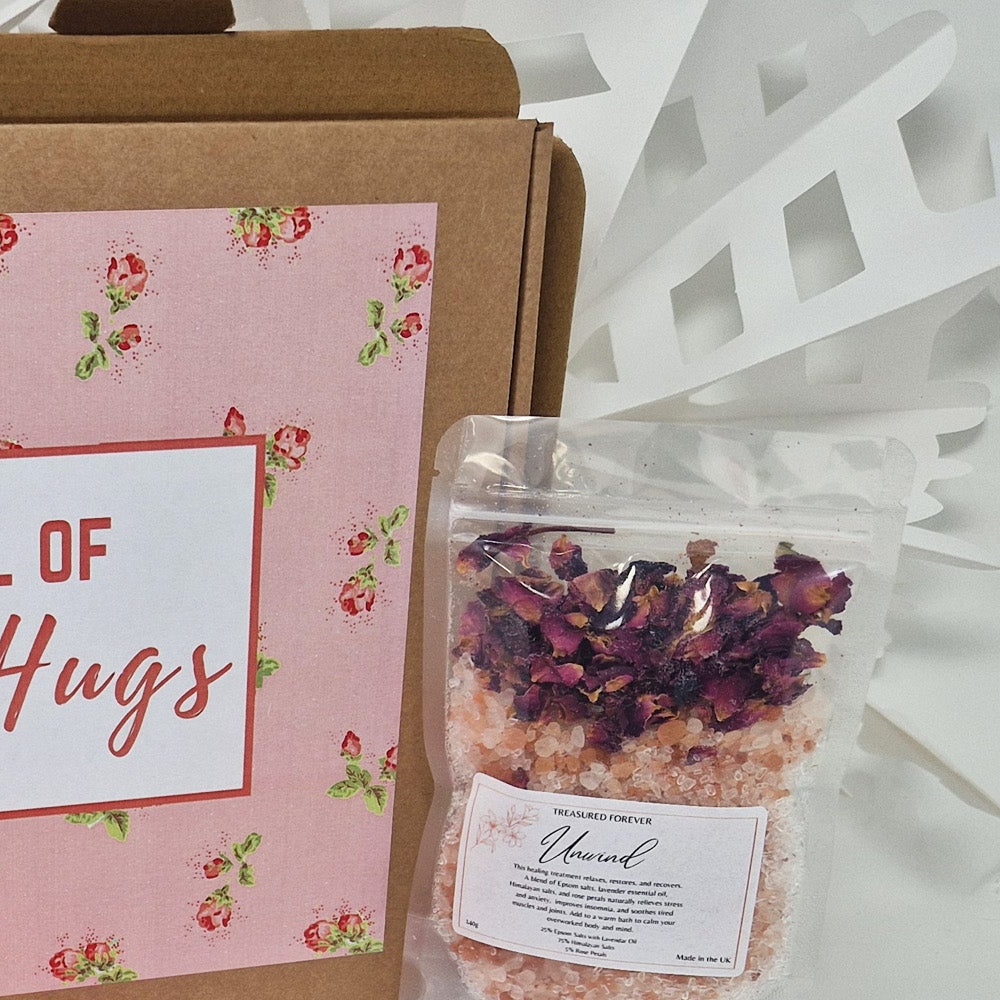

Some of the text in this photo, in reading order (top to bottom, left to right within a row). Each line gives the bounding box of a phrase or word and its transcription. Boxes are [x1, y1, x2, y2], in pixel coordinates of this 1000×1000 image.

[38, 516, 112, 584] OF
[553, 808, 653, 825] TREASURED FOREVER
[538, 825, 659, 869] Unwind
[526, 866, 548, 876] healing
[550, 871, 581, 879] treatment
[582, 876, 607, 884] relaxes,
[509, 881, 540, 891] Himalayan
[607, 897, 635, 905] naturally
[530, 876, 548, 884] blend
[598, 886, 625, 894] lavender
[512, 901, 534, 909] muscles
[555, 900, 583, 908] improves
[546, 917, 583, 927] overworked
[584, 922, 599, 930] body
[698, 954, 704, 962] in
